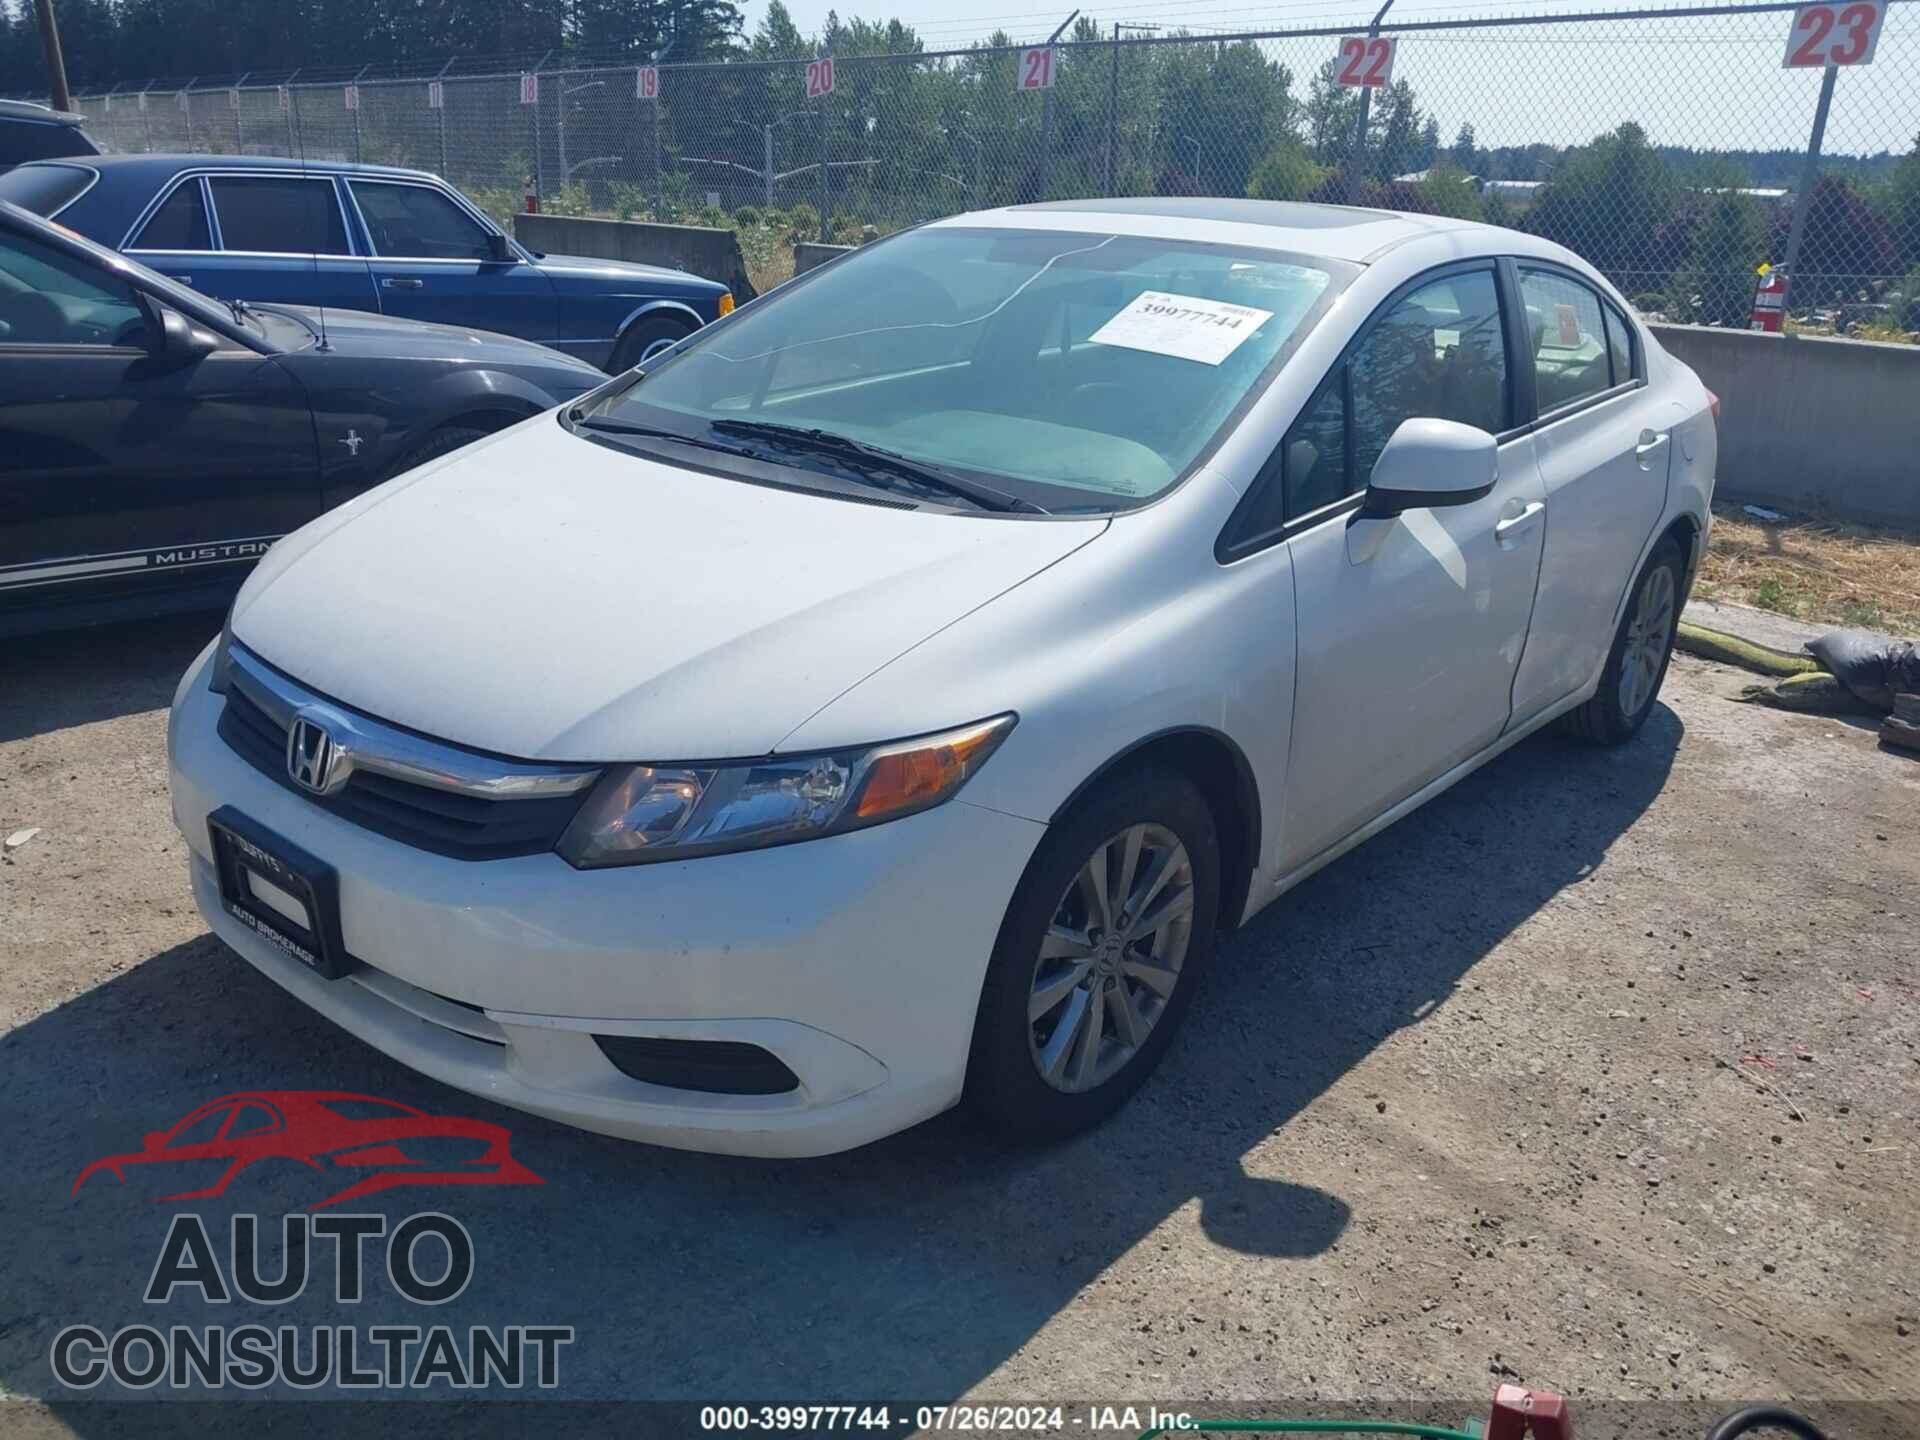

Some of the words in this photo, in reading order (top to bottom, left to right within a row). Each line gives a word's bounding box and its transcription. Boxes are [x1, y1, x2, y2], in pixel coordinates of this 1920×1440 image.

[1790, 3, 1877, 66] 23
[1024, 50, 1051, 88] 21
[1338, 37, 1390, 85] 22
[523, 76, 536, 102] 18
[639, 68, 657, 97] 19
[808, 59, 833, 97] 20
[1136, 303, 1243, 329] 39977744
[156, 542, 272, 565] MUSTAN
[231, 903, 256, 927] AUTO
